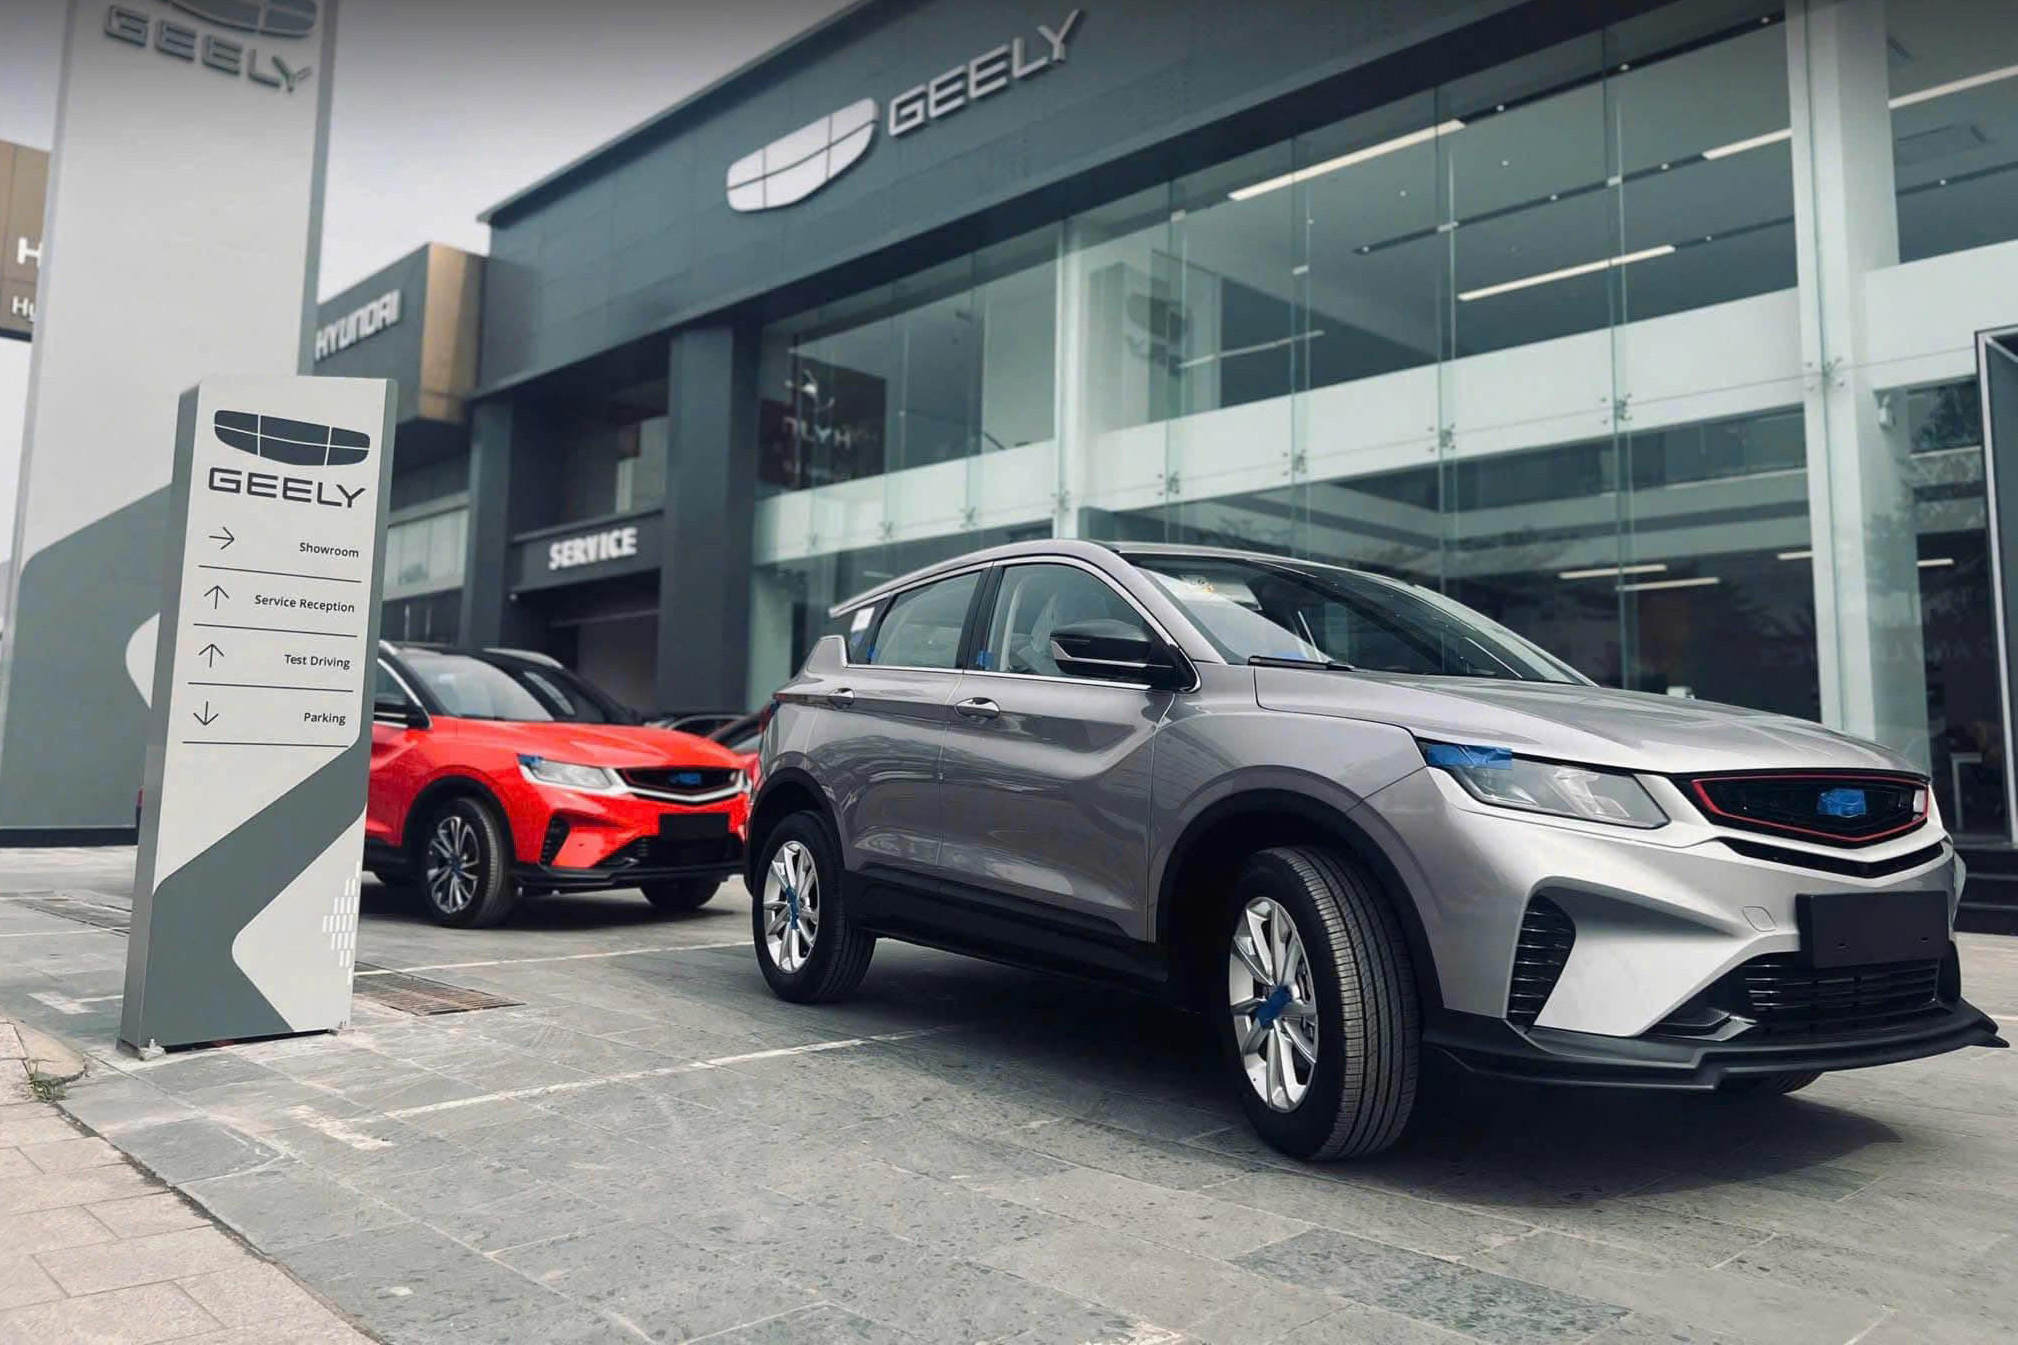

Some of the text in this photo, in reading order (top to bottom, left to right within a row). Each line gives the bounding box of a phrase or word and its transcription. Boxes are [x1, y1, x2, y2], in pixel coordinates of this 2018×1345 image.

[104, 4, 312, 92] GEELY
[889, 8, 1080, 136] GEELY
[314, 289, 400, 360] HYUNDAI
[208, 467, 366, 508] GEELY
[299, 542, 359, 558] Showroom
[548, 527, 638, 570] SERVICE
[254, 594, 355, 613] Service Reception
[284, 654, 350, 670] Test Driving
[303, 712, 346, 726] Parking
